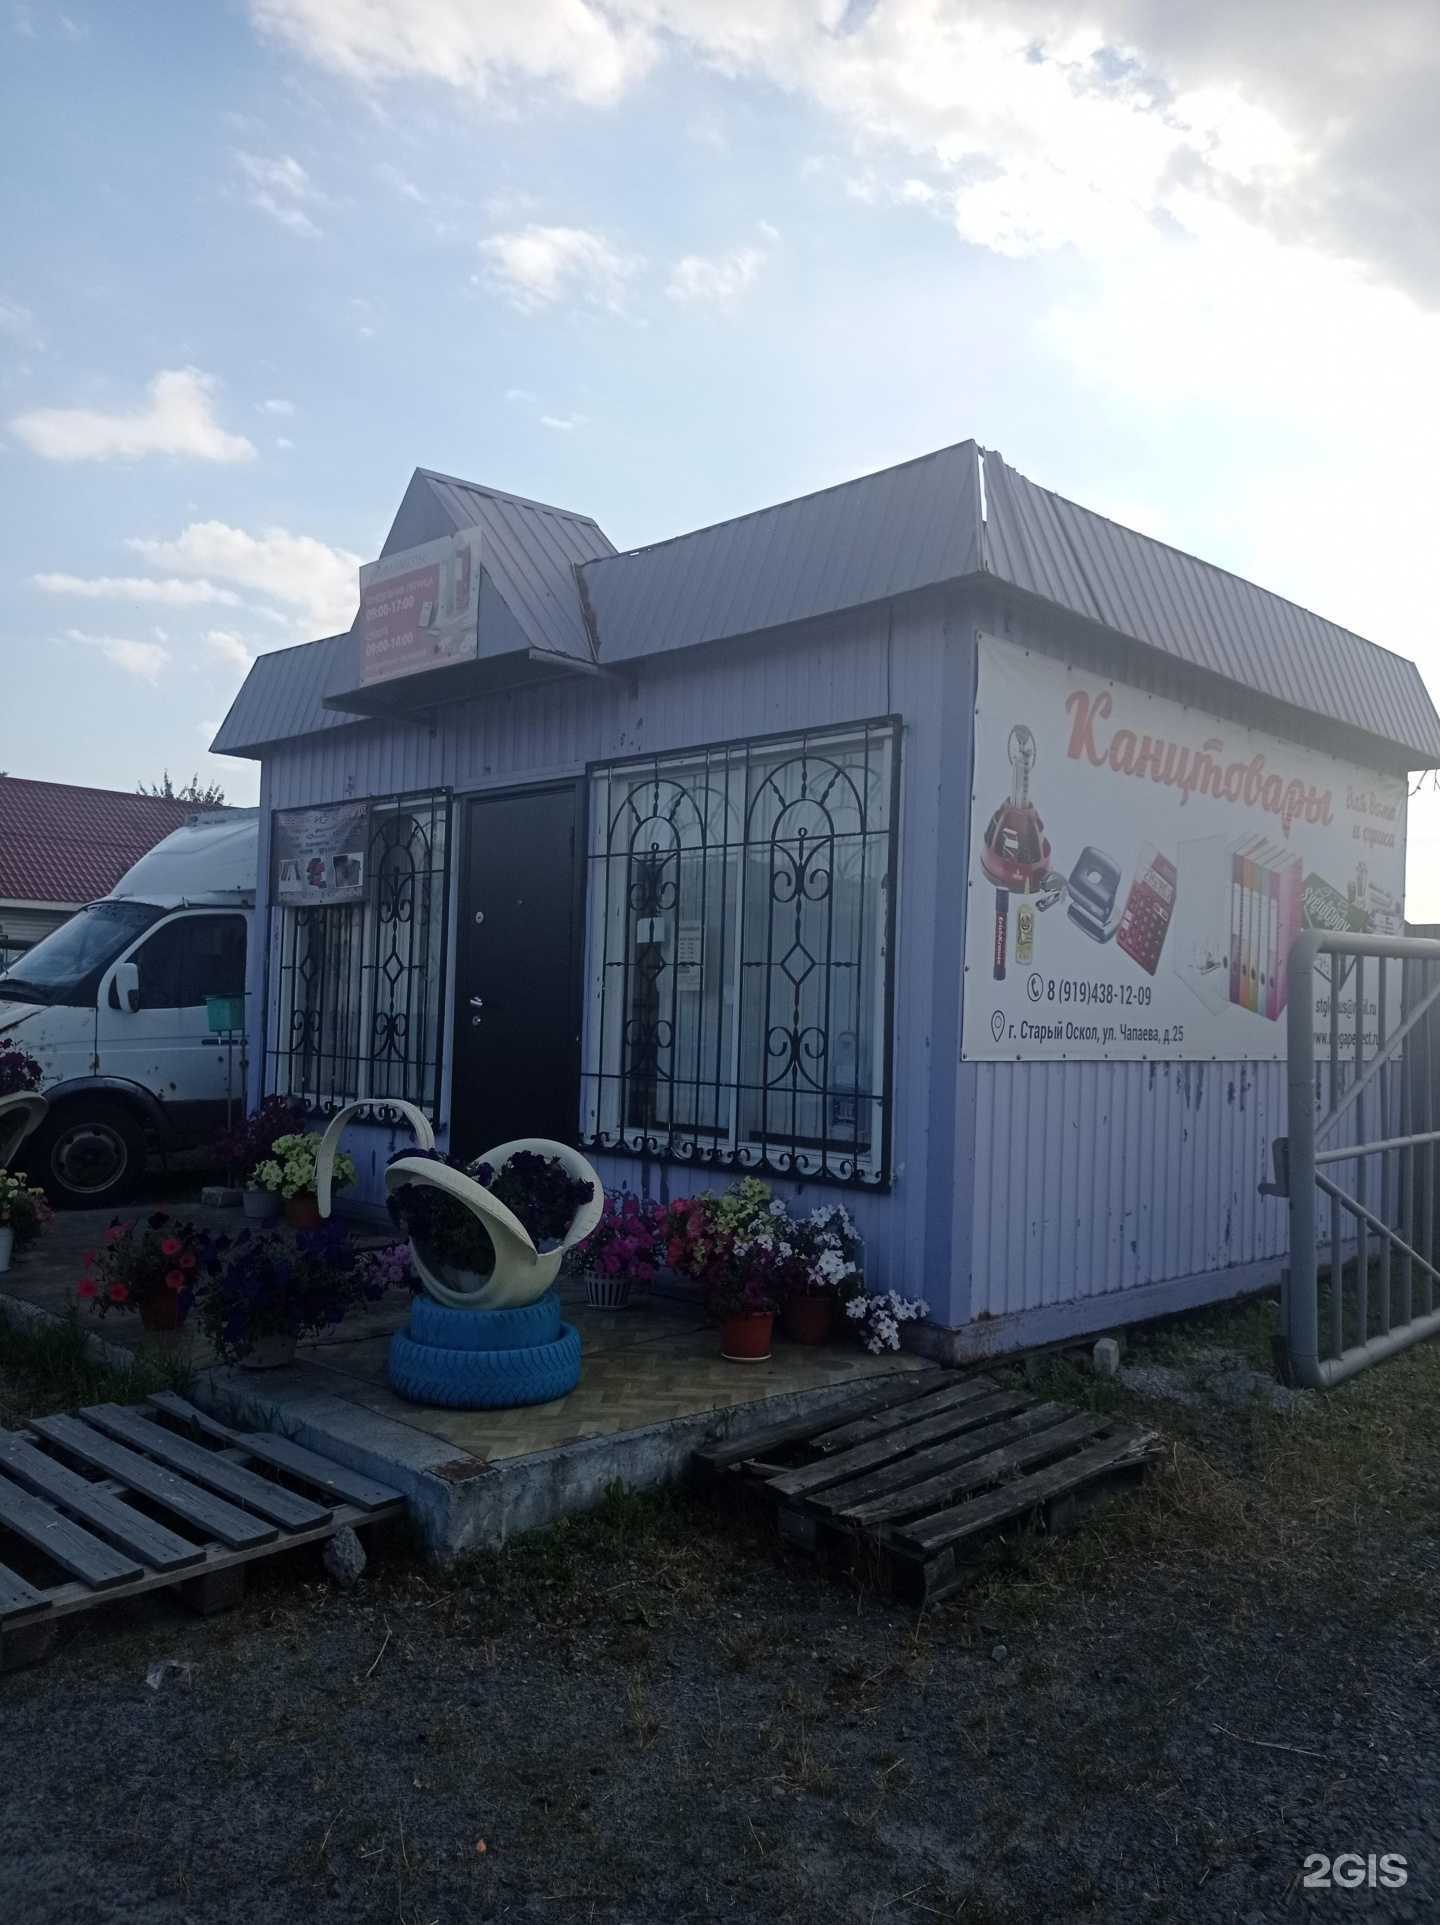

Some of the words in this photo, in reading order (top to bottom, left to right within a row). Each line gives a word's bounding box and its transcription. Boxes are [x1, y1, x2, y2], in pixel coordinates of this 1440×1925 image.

[1065, 690, 1334, 839] Канцтовары
[1047, 980, 1056, 1001] 8
[1058, 979, 1152, 1006] (919)438-12-09
[1008, 1026, 1017, 1040] г.
[1020, 1020, 1063, 1044] Старый
[1065, 1022, 1100, 1043] Оскол,
[1102, 1028, 1117, 1045] ул.
[1120, 1024, 1161, 1044] Чапаева,
[1163, 1025, 1184, 1045] д.25
